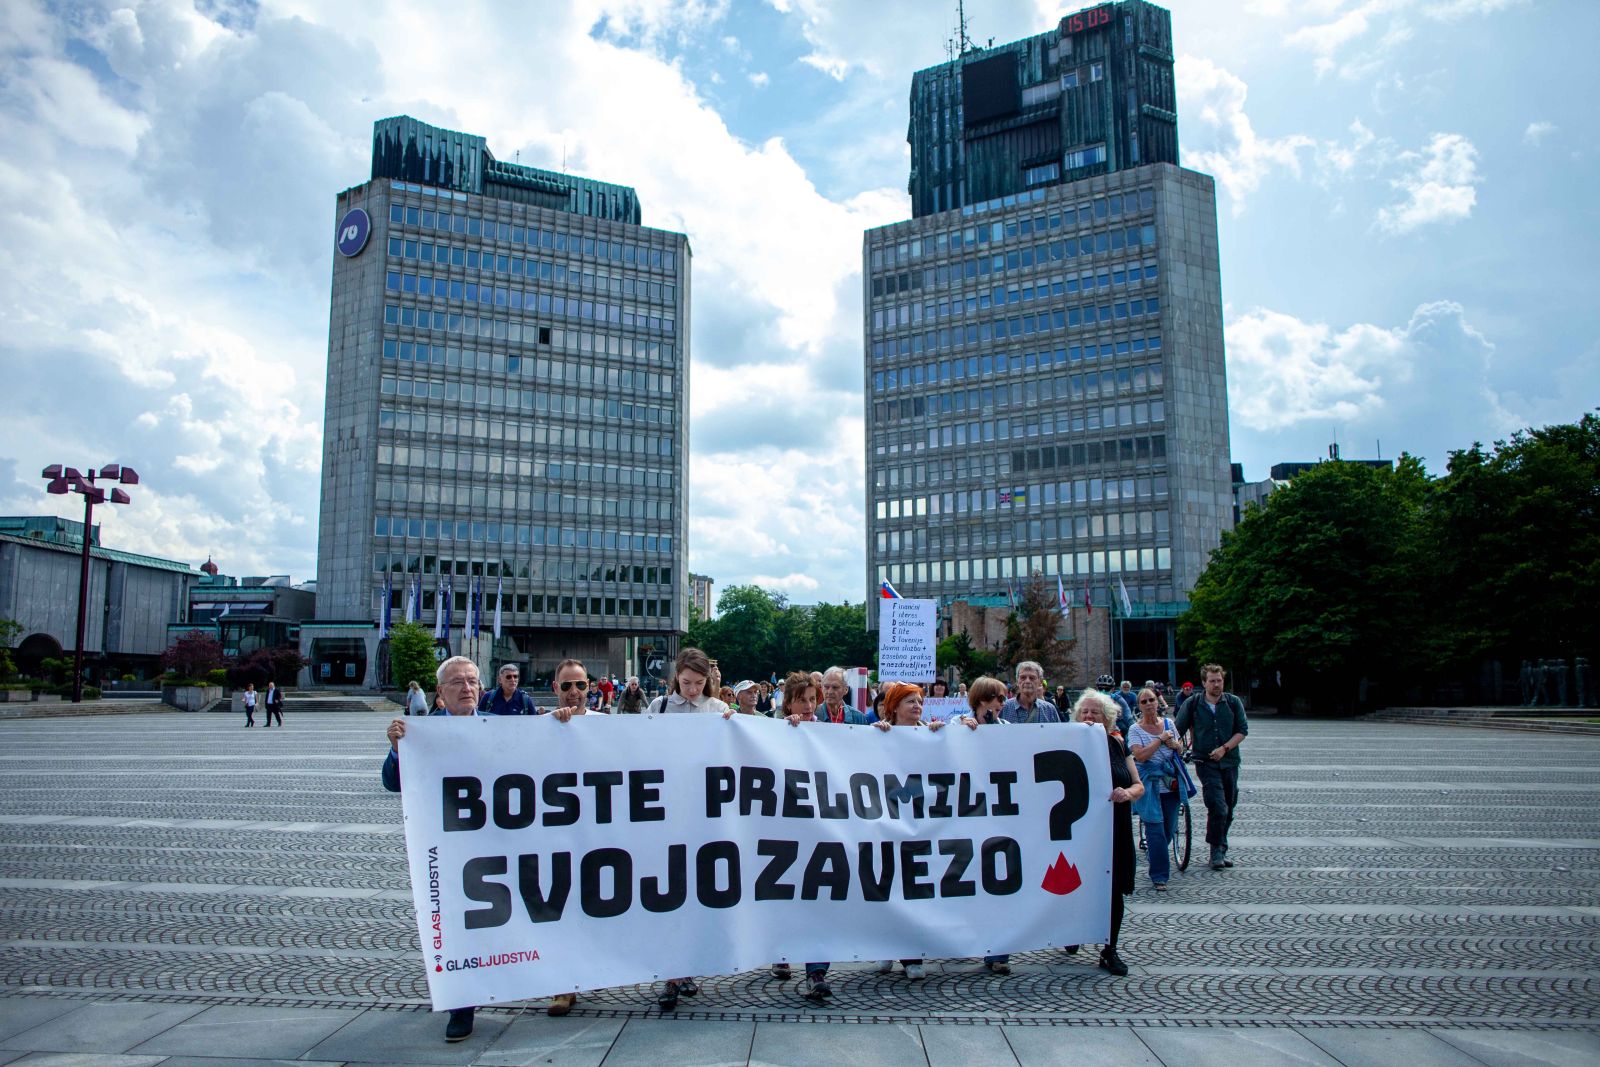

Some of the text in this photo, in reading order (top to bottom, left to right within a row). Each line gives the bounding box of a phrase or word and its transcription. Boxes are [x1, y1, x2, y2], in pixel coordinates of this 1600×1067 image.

[442, 750, 1089, 841] BOSTE PRELOMILI ?
[428, 846, 443, 950] GLASLJUDSTVA
[446, 949, 540, 972] GLASLJUDSTVA
